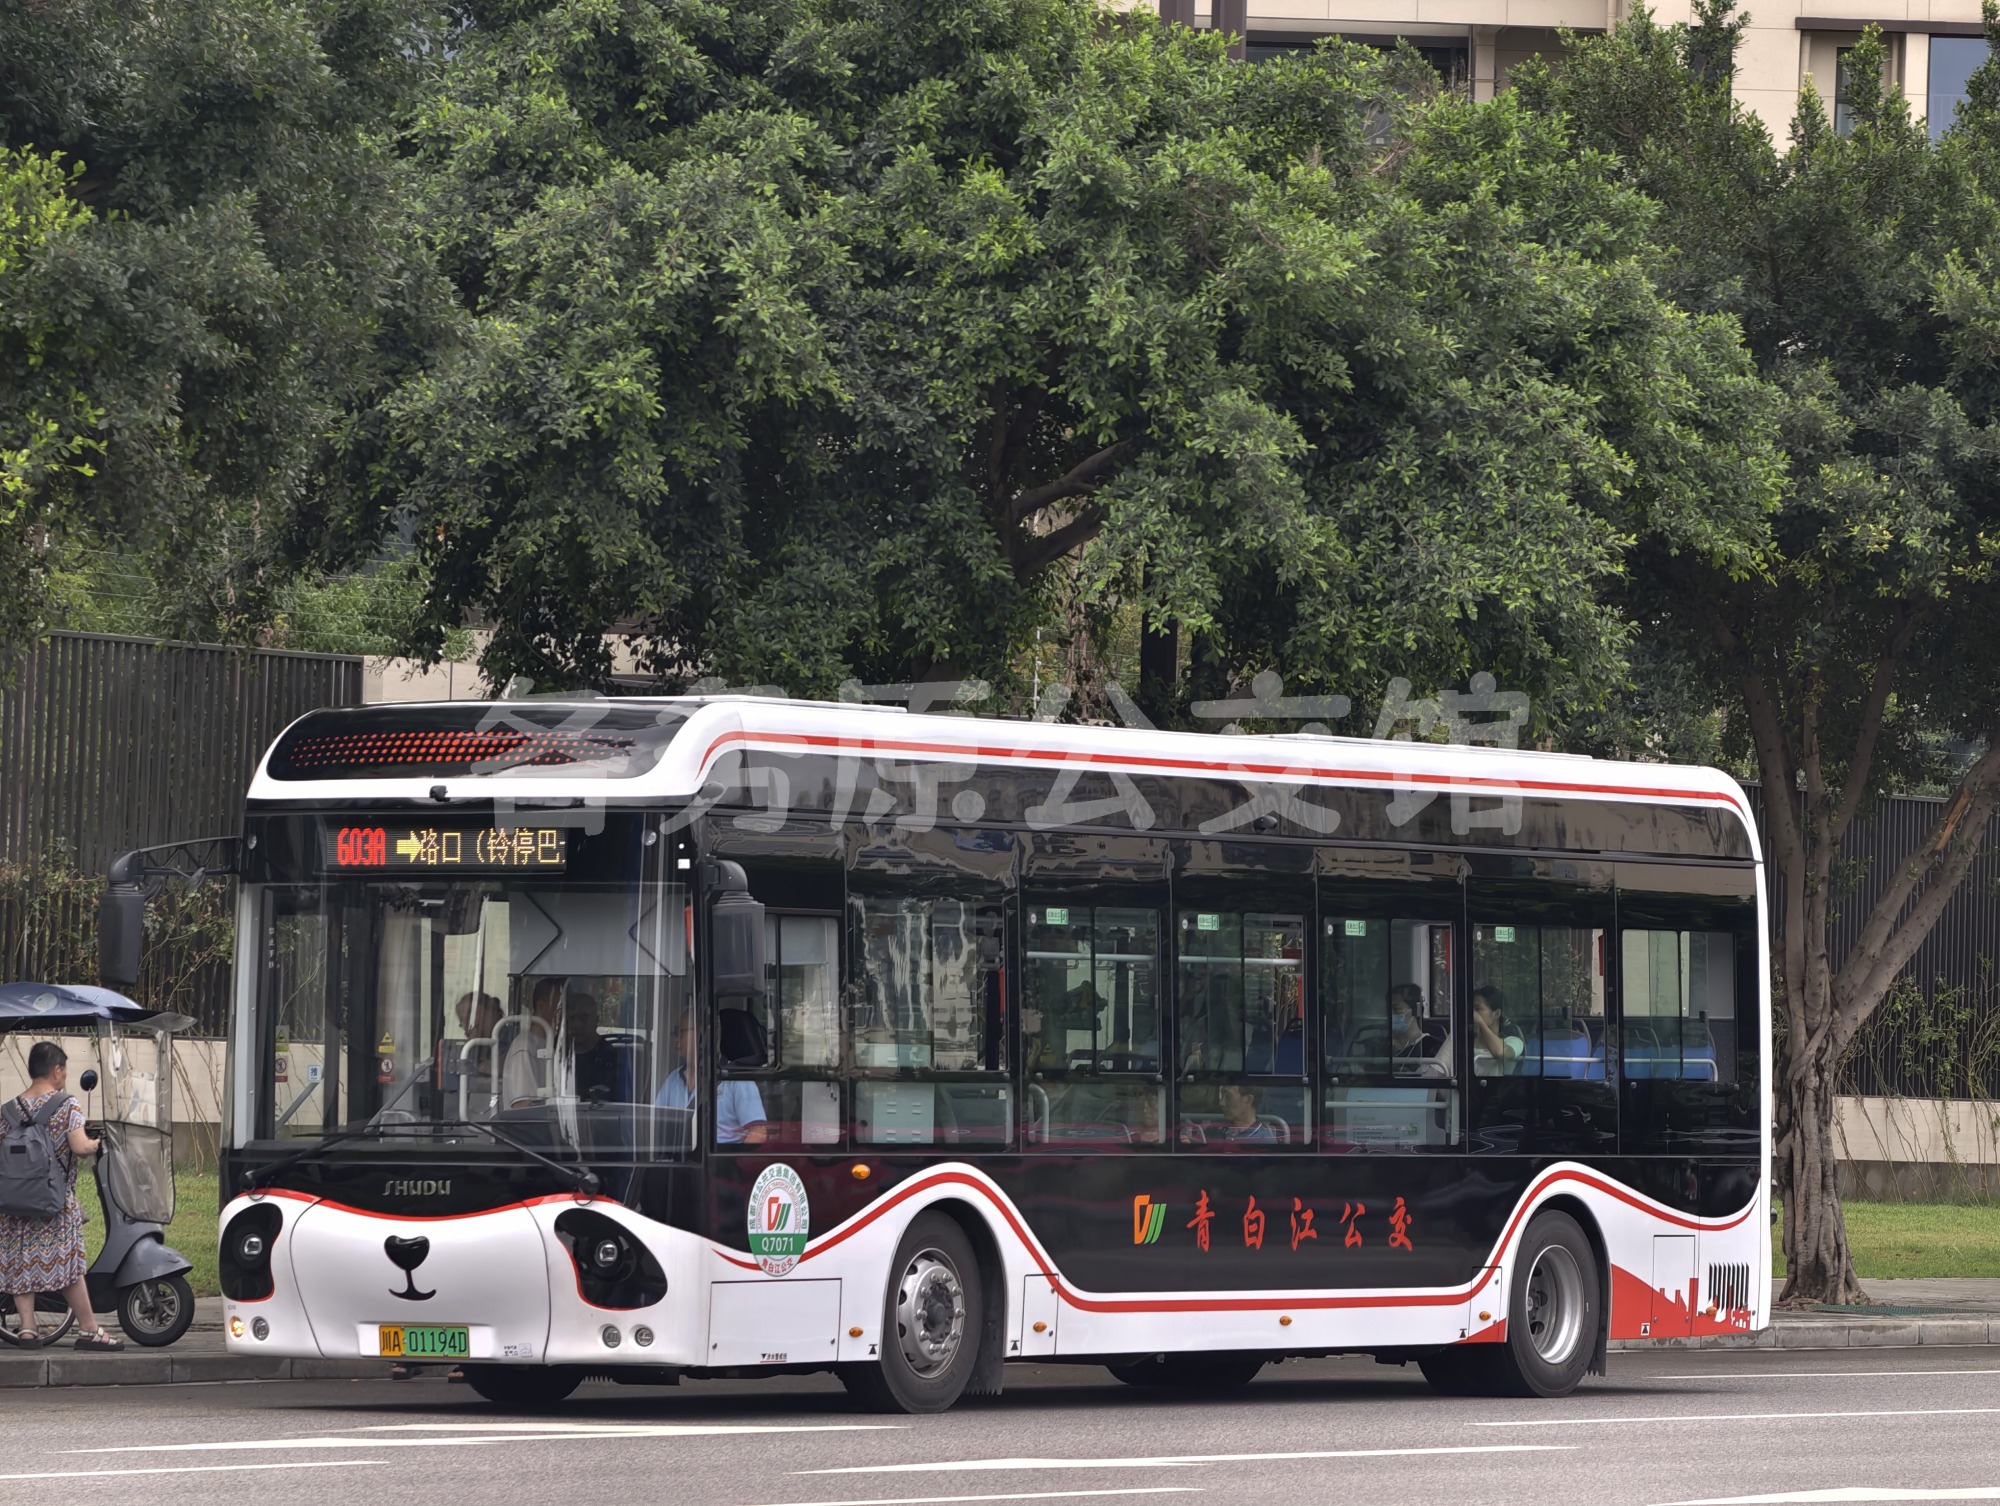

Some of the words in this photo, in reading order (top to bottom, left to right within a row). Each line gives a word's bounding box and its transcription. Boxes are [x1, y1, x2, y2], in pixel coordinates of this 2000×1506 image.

[337, 828, 386, 866] 603A
[382, 1180, 451, 1196] SHUDU
[1186, 1190, 1412, 1252] 青白江公交
[761, 1238, 793, 1251] Q7071
[762, 1258, 793, 1273] 青白江公交
